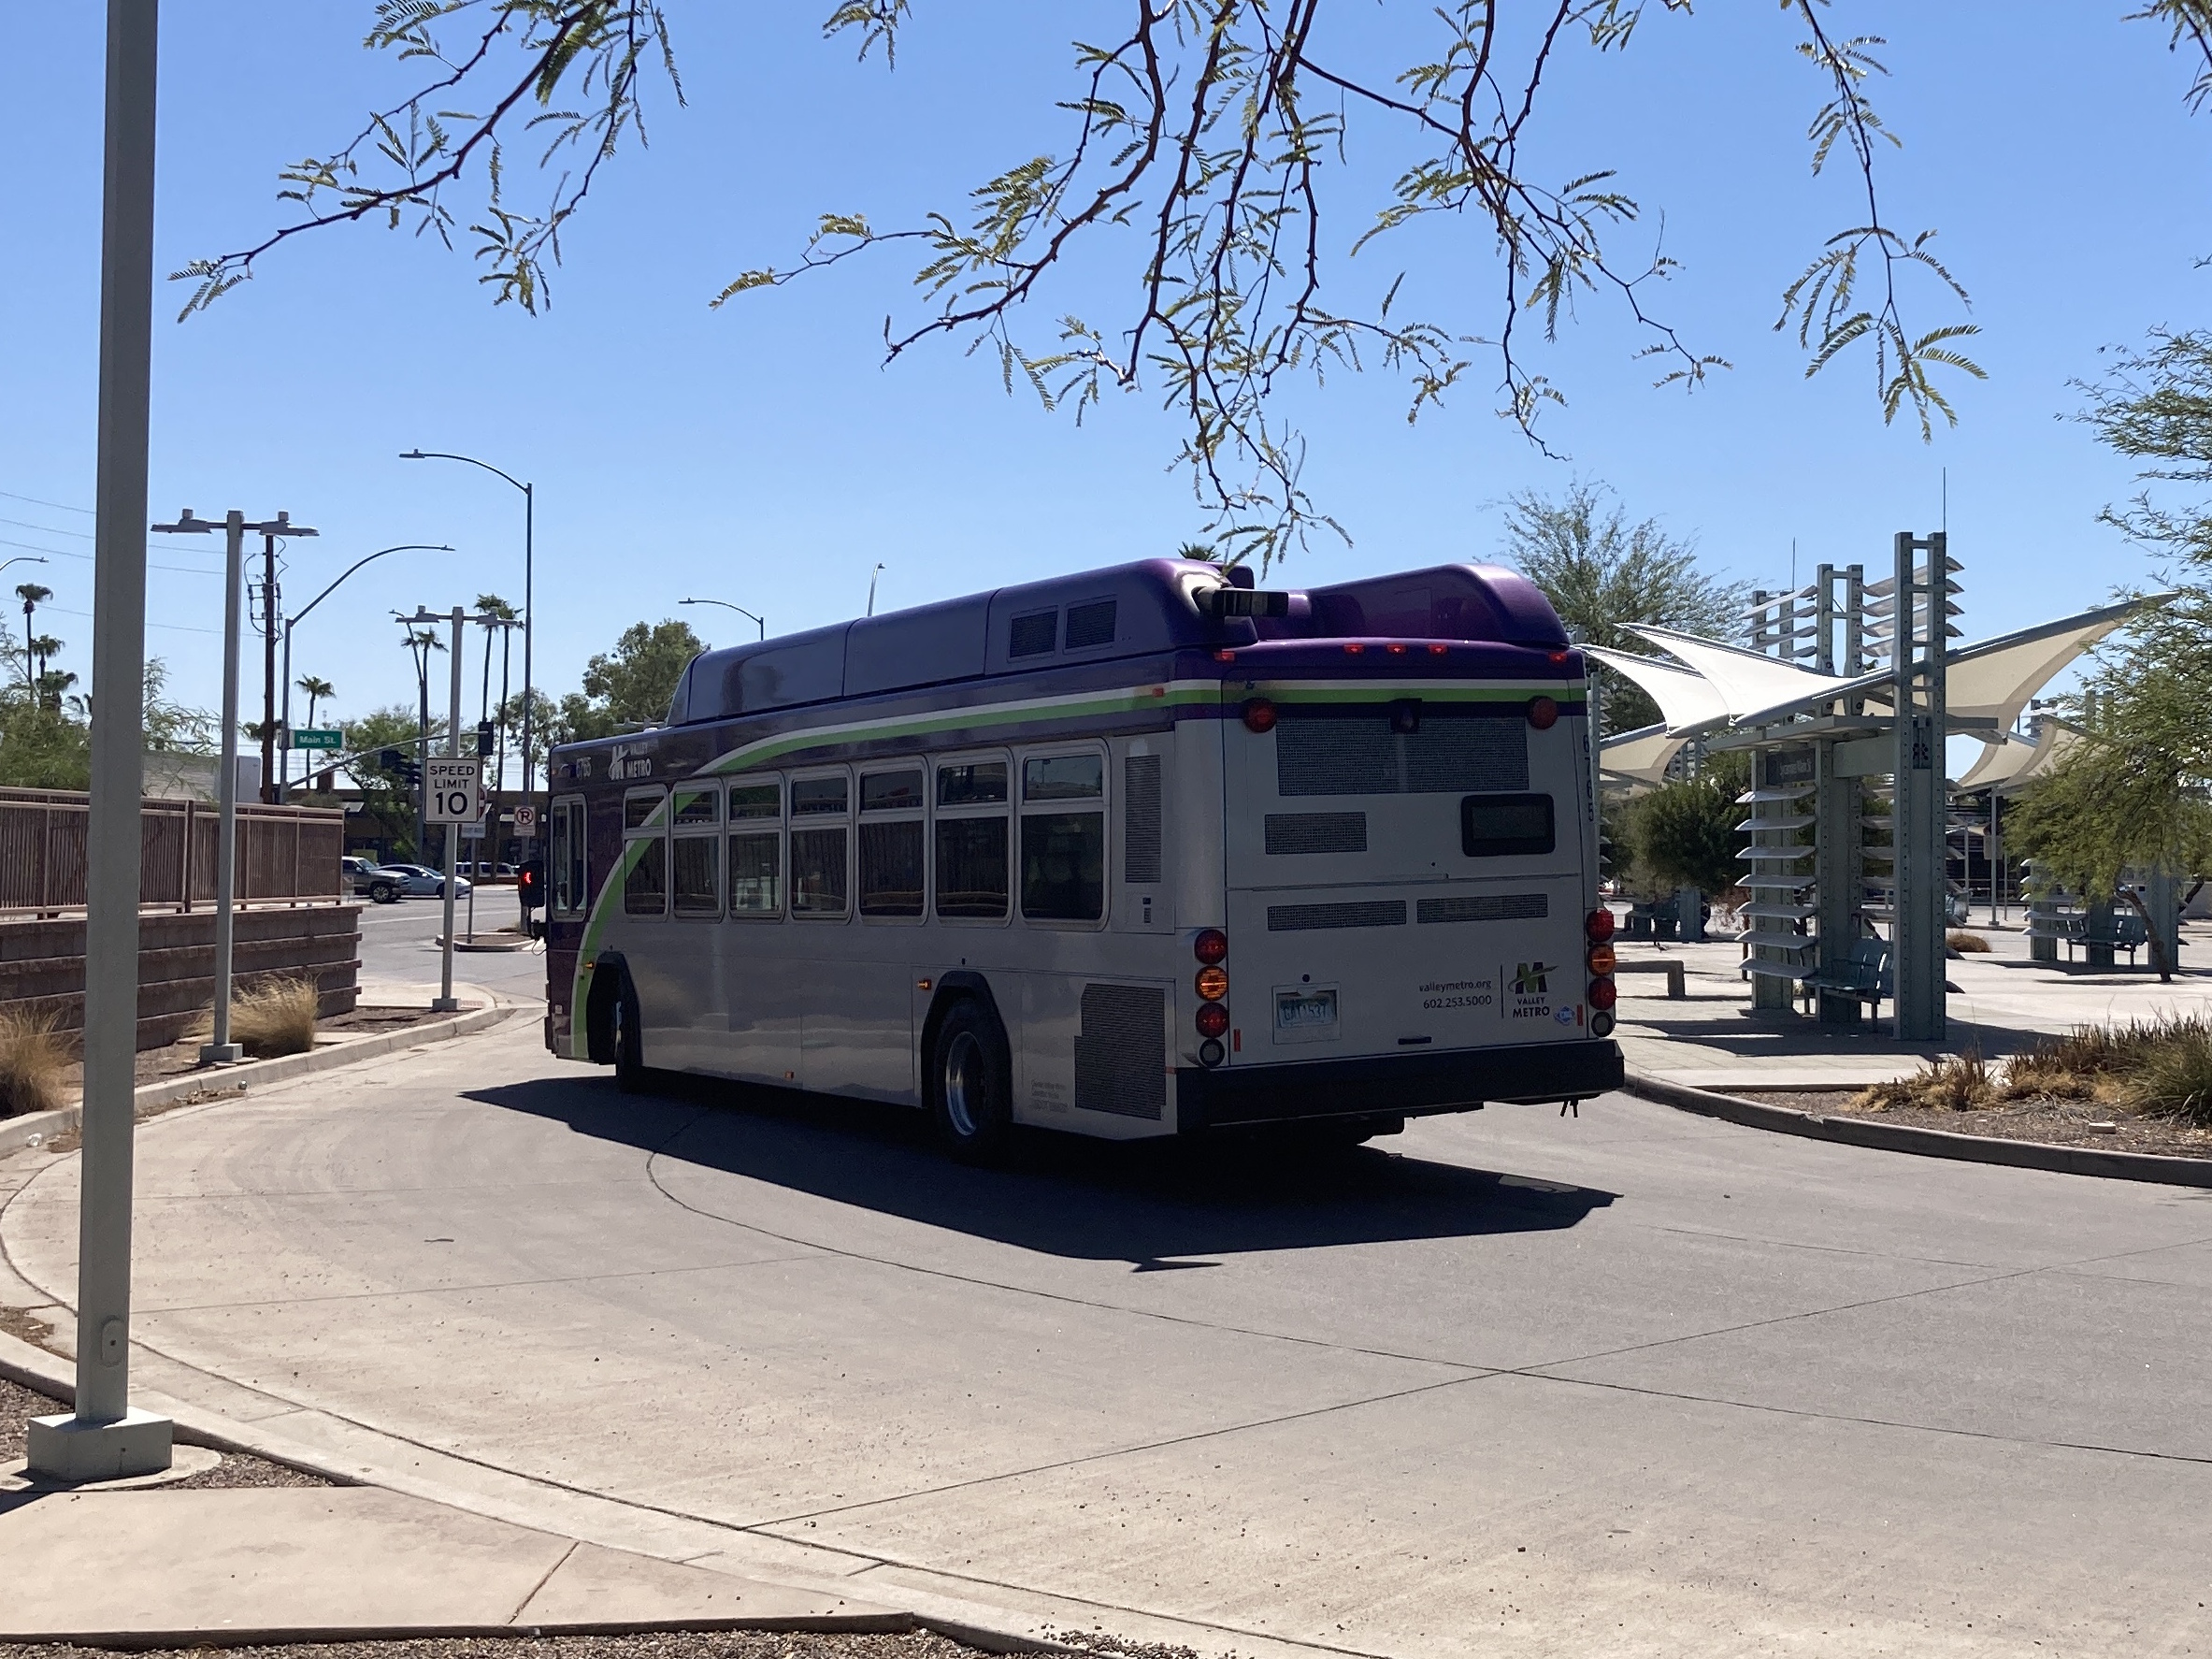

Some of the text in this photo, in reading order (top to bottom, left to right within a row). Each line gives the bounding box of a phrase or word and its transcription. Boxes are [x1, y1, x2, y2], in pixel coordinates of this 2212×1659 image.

[299, 735, 322, 743] Main
[429, 765, 475, 776] SPEED
[627, 758, 652, 778] METRO
[434, 779, 470, 789] LIMIT
[436, 791, 468, 815] 10
[1419, 979, 1492, 993] valleymetro.org
[1423, 994, 1492, 1009] 602.253.5000
[1517, 997, 1545, 1005] VALLEY
[1512, 1005, 1550, 1018] METRO
